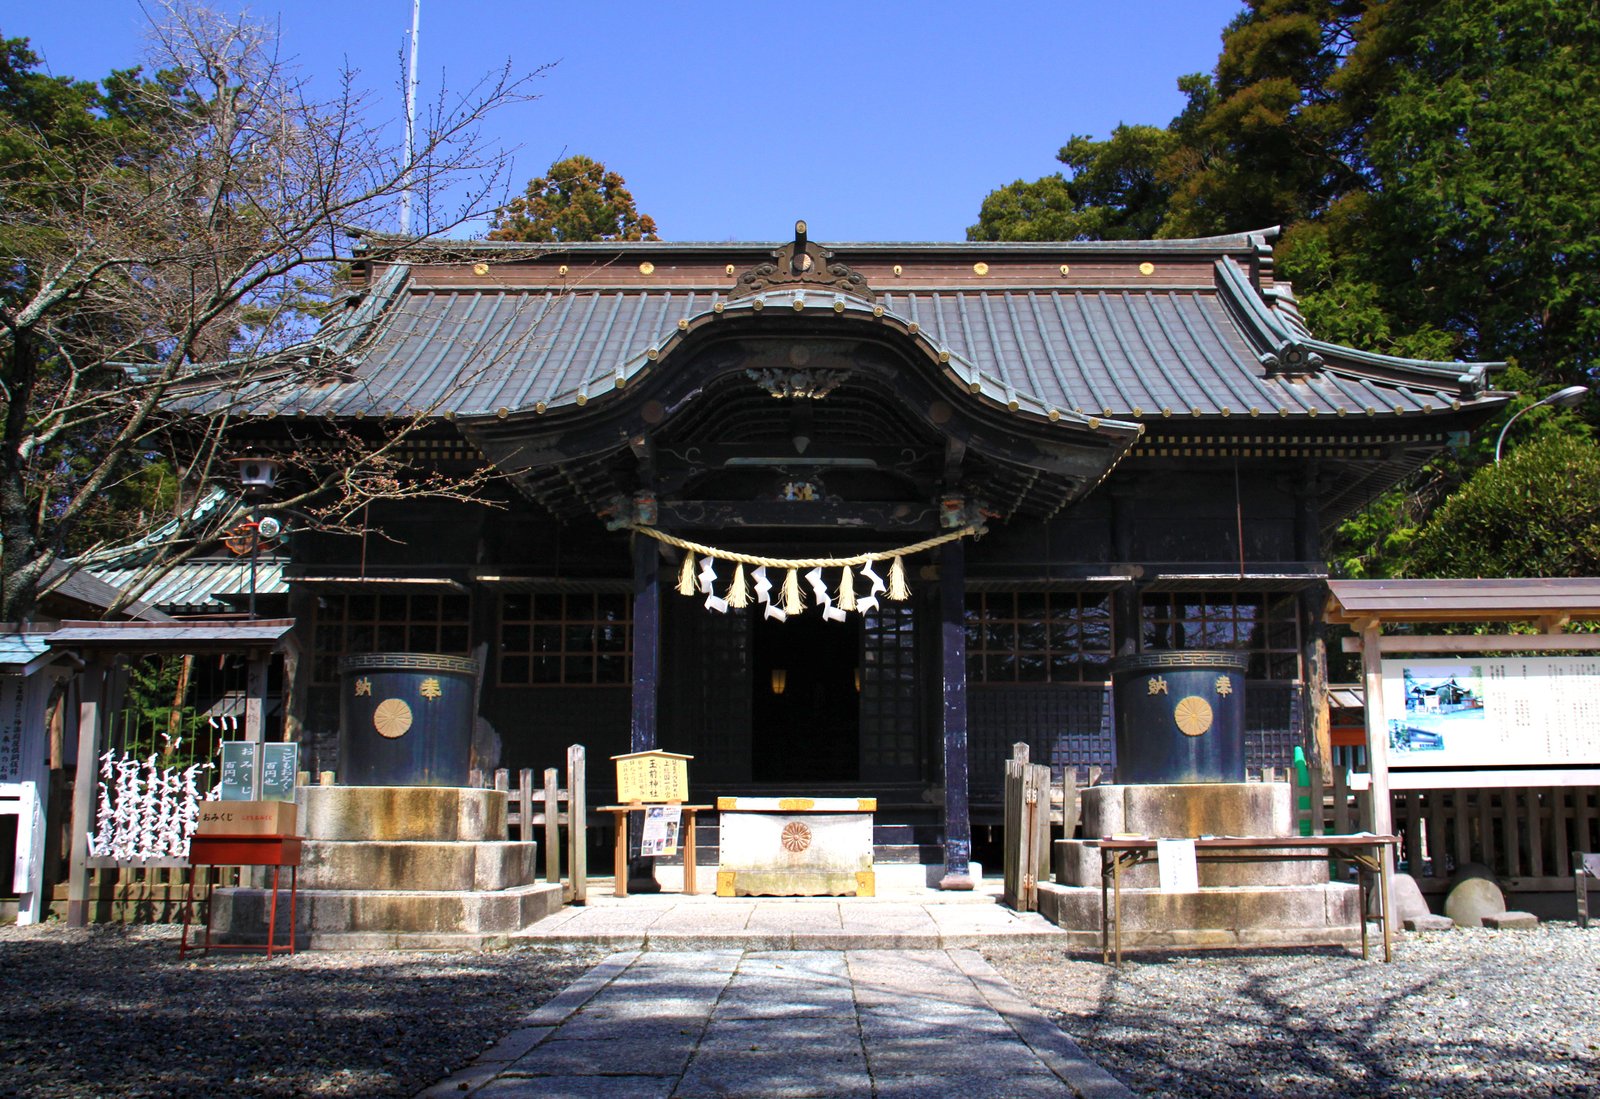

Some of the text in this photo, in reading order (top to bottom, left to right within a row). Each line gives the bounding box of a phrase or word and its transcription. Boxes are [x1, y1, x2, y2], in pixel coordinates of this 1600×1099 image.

[355, 676, 442, 702] 奉 納
[1147, 674, 1233, 698] 奉 納
[223, 761, 238, 785] 百円也
[240, 748, 253, 794] おみくじ
[264, 761, 279, 786] 百円也
[280, 748, 294, 792] こどもおみく
[203, 812, 233, 822] おみくじ
